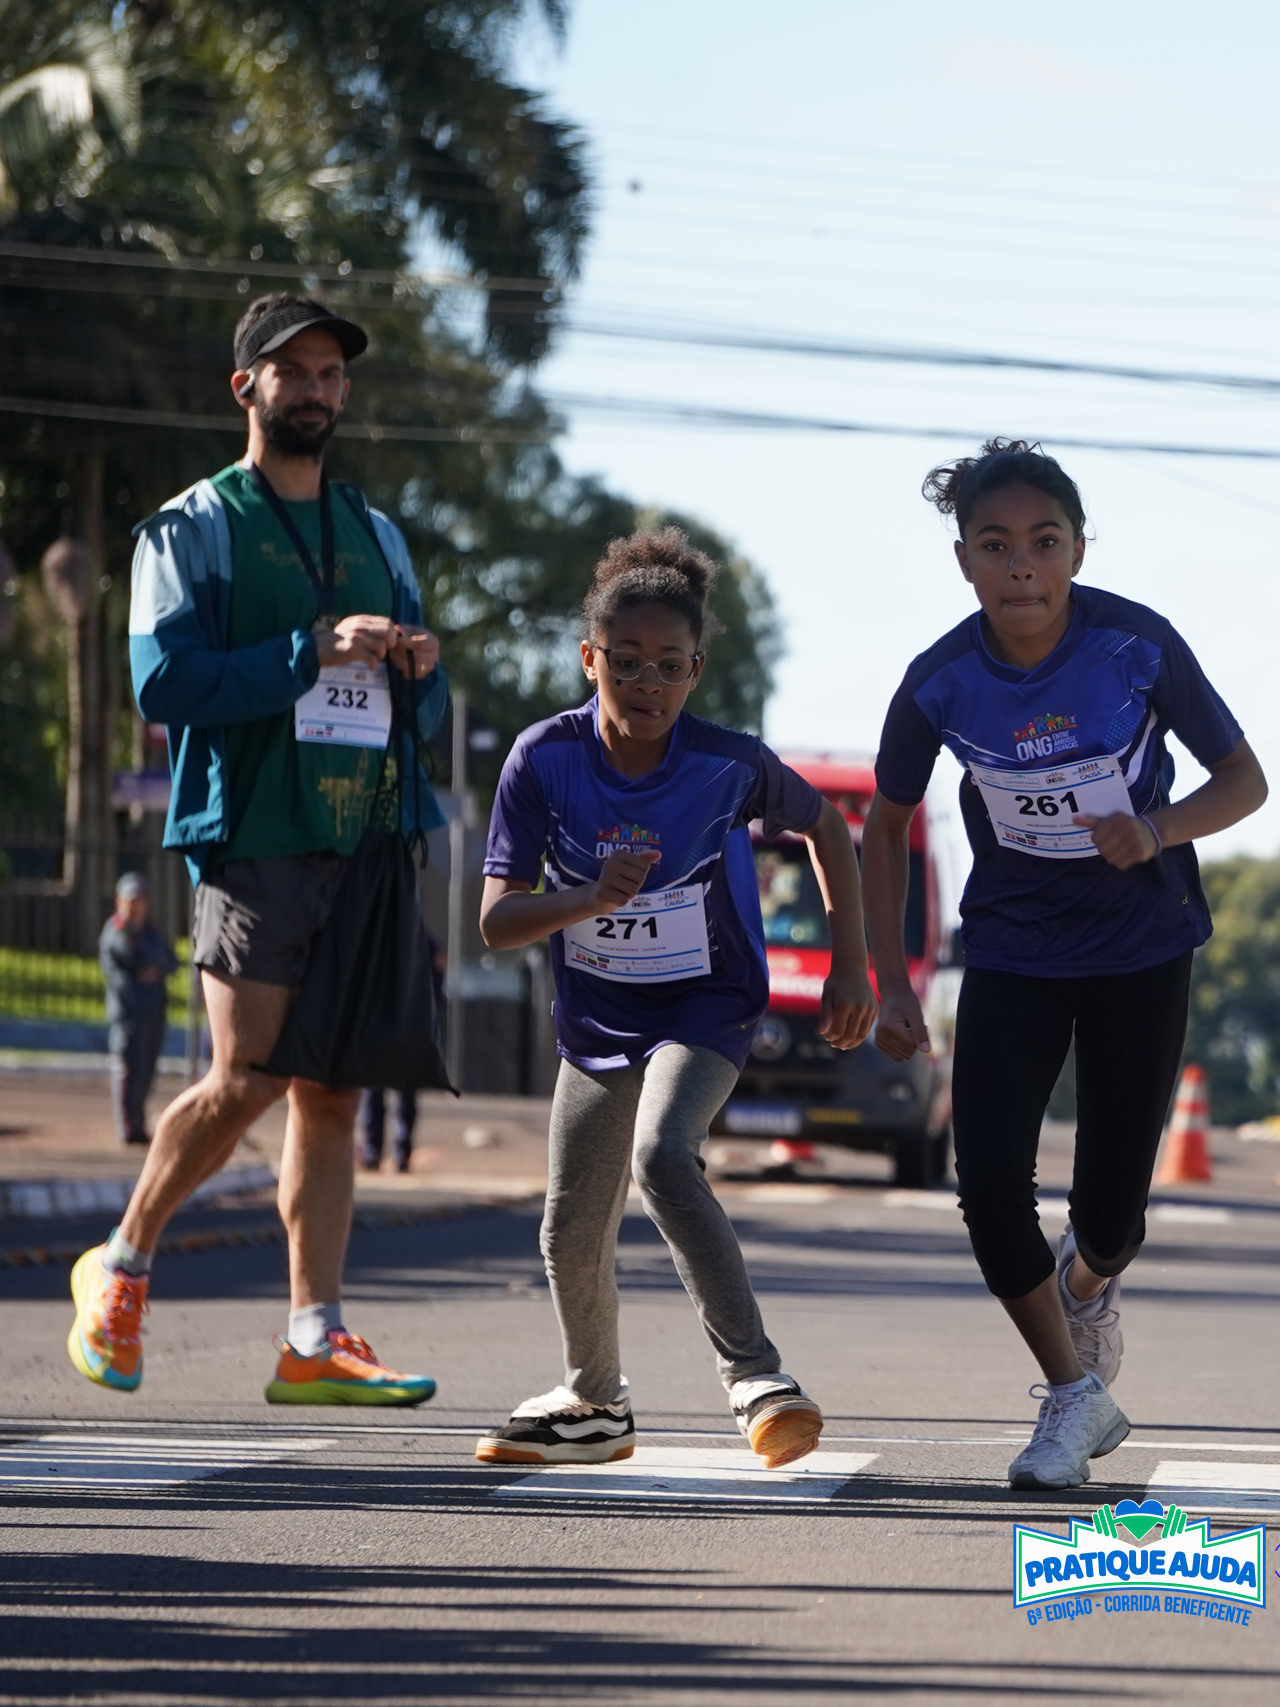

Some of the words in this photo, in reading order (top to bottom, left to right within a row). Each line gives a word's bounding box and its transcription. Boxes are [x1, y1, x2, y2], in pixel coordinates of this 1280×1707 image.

[326, 687, 368, 710] 232
[1052, 730, 1070, 740] ENTRE
[1016, 735, 1053, 762] ONG
[1080, 771, 1103, 780] CAUSA
[1014, 791, 1080, 817] 261
[595, 916, 658, 940] 271
